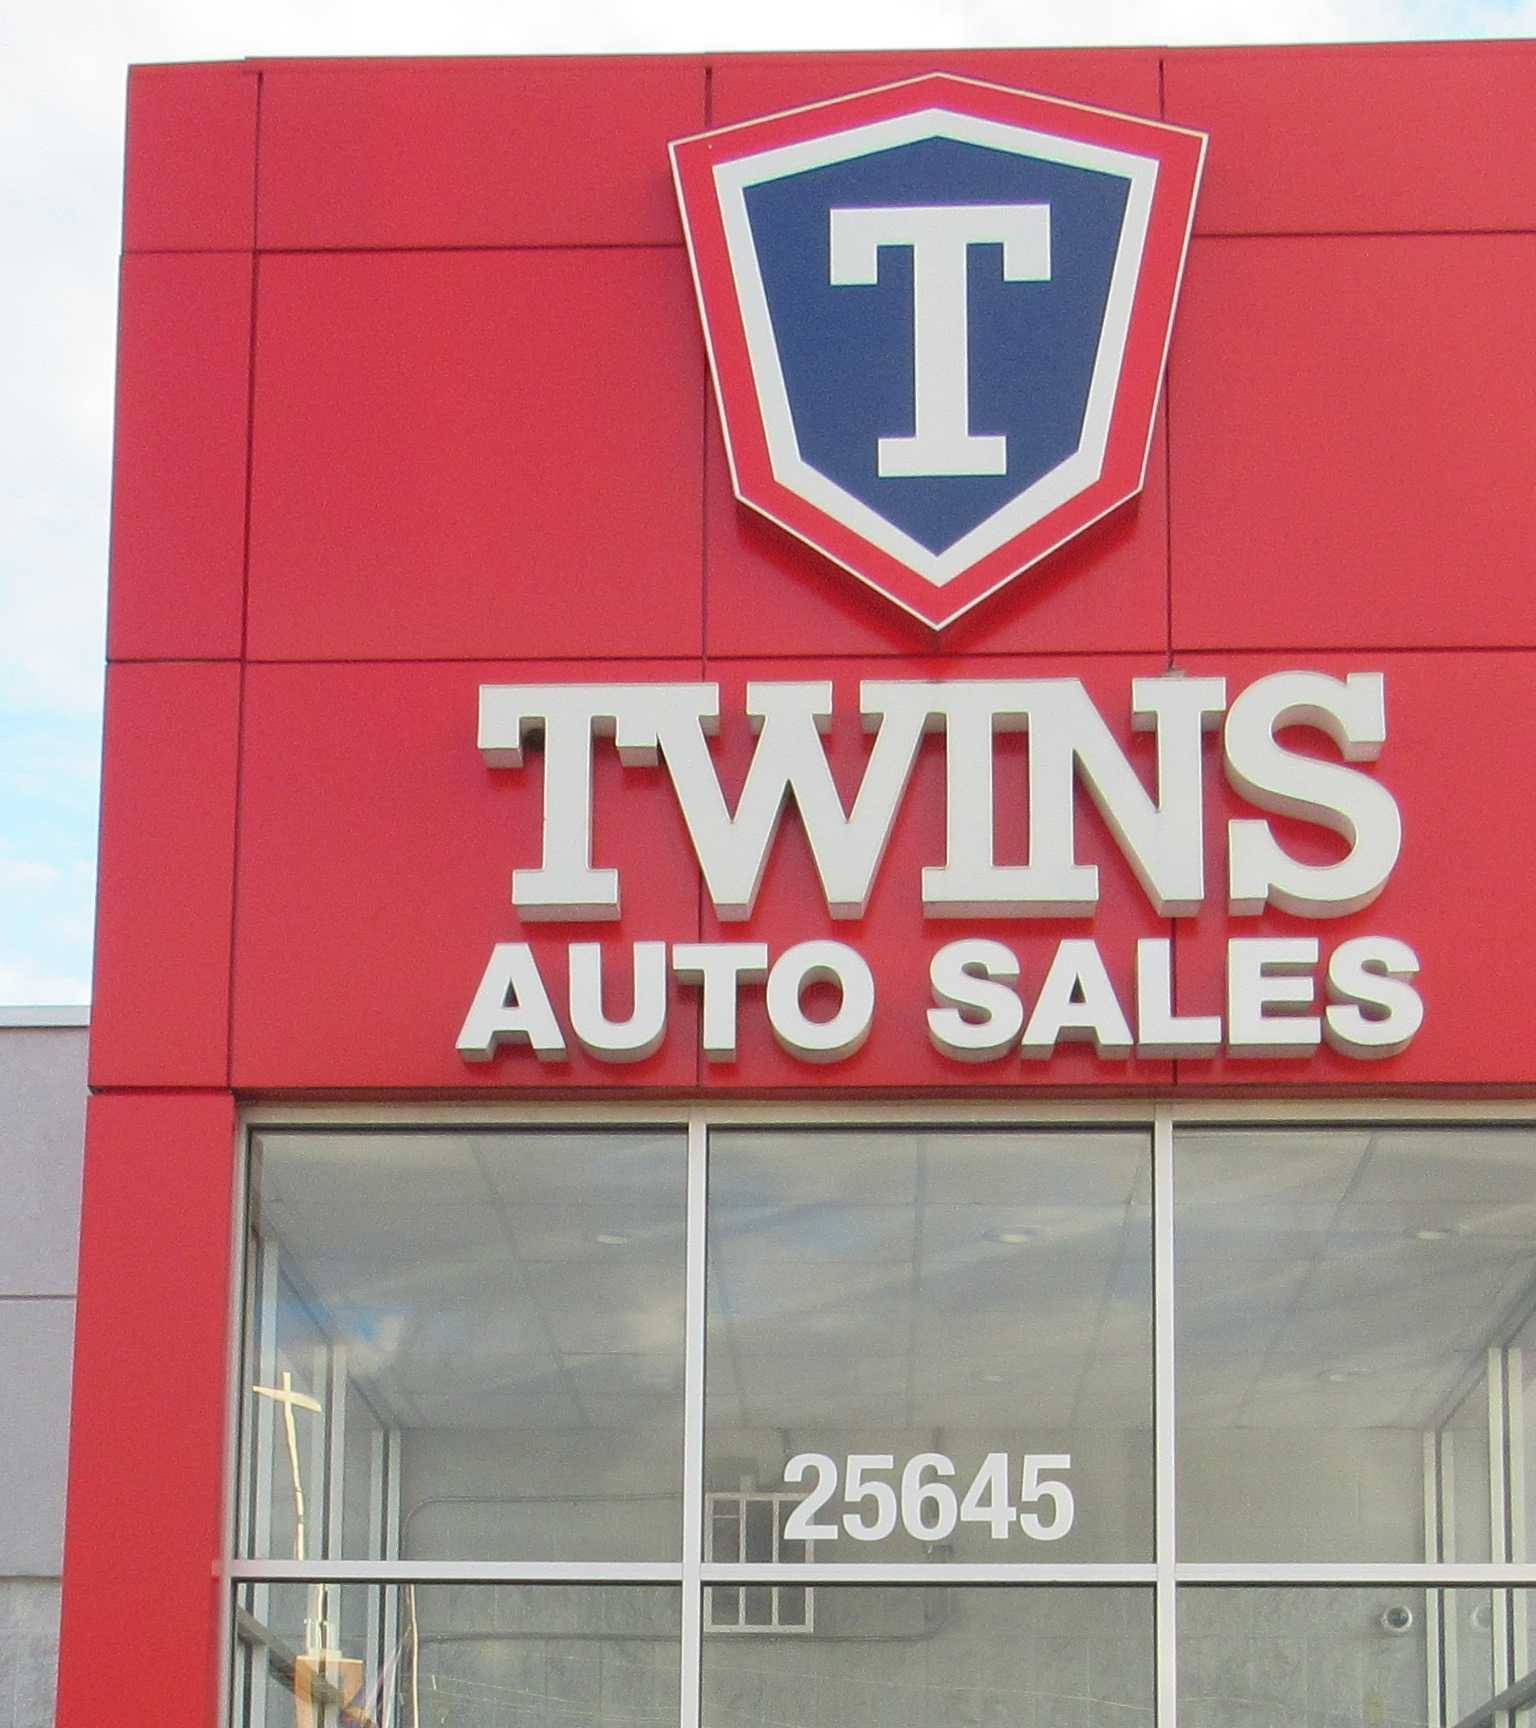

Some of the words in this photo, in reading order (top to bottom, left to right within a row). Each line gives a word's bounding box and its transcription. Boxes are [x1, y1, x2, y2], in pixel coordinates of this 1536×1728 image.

[830, 203, 1051, 478] T
[477, 670, 1401, 922] TWINS
[454, 938, 875, 1063] AUTO
[926, 936, 1424, 1061] SALES
[782, 1452, 1075, 1542] 25645
